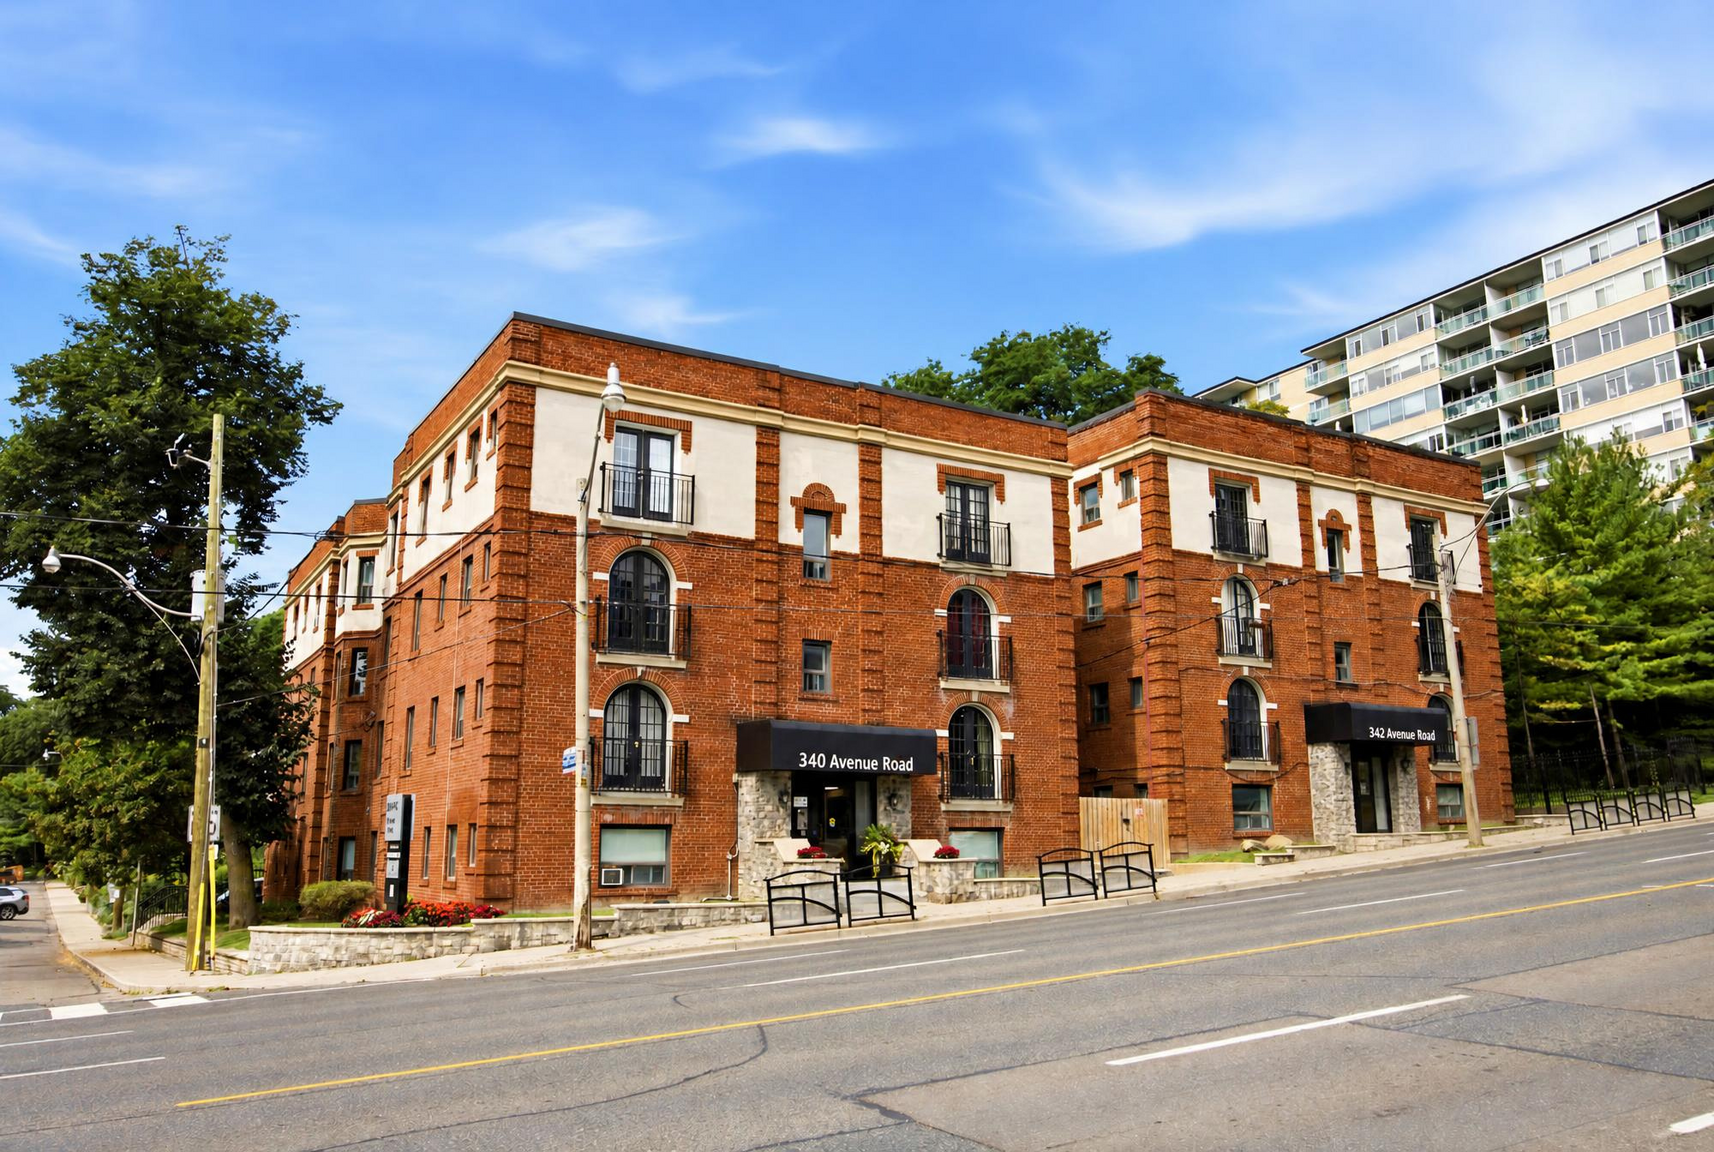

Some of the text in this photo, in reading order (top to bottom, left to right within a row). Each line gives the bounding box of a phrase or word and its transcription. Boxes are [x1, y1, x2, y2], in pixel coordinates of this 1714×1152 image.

[1369, 726, 1436, 741] 342 Avenue Road
[798, 752, 914, 772] 340 Avenue Road
